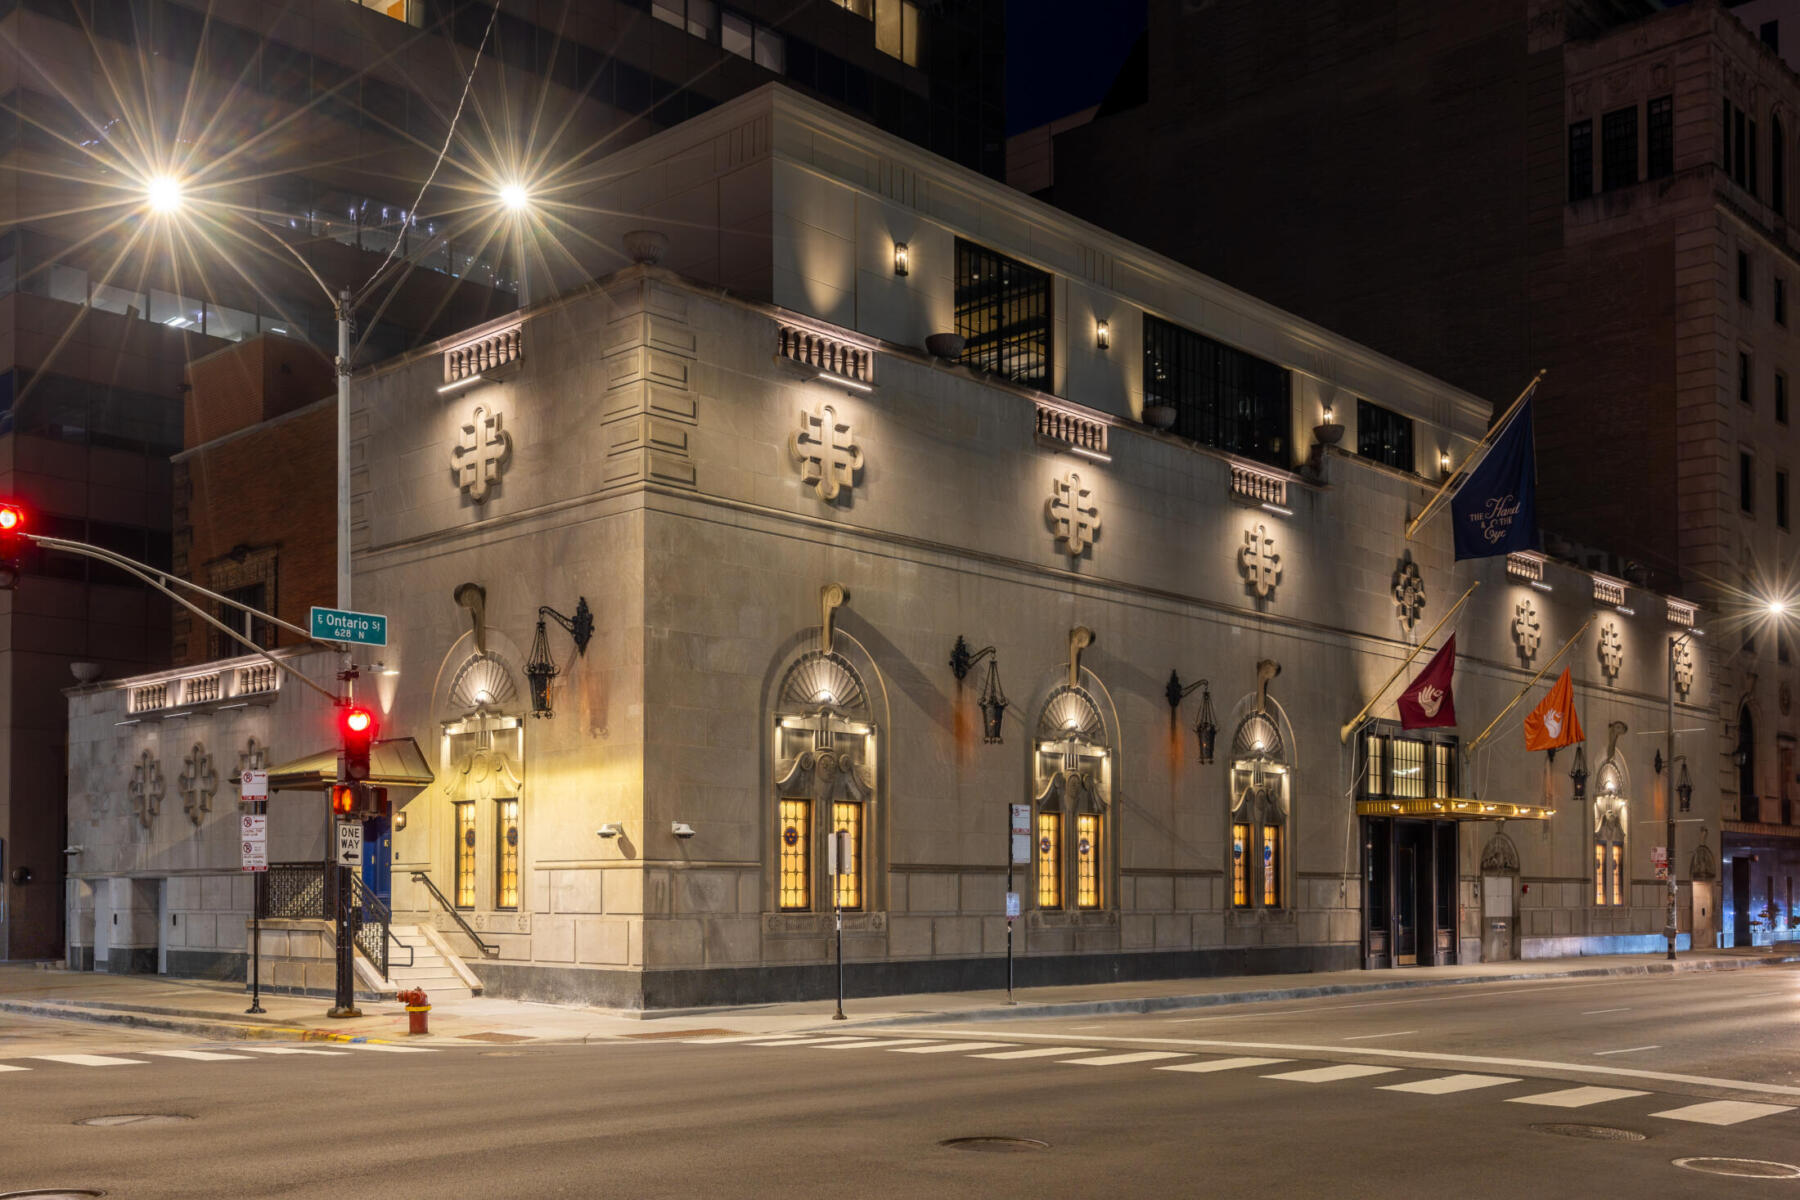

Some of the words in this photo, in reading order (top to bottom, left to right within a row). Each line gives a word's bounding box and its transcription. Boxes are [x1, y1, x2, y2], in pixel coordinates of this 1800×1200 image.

[1469, 513, 1485, 521] THE
[1485, 494, 1521, 519] Hand
[1484, 518, 1507, 544] Eye
[317, 614, 324, 624] E
[326, 614, 369, 630] Ontario
[334, 628, 352, 638] 628
[358, 631, 365, 639] N
[341, 827, 360, 838] ONE
[341, 838, 360, 849] WAY
